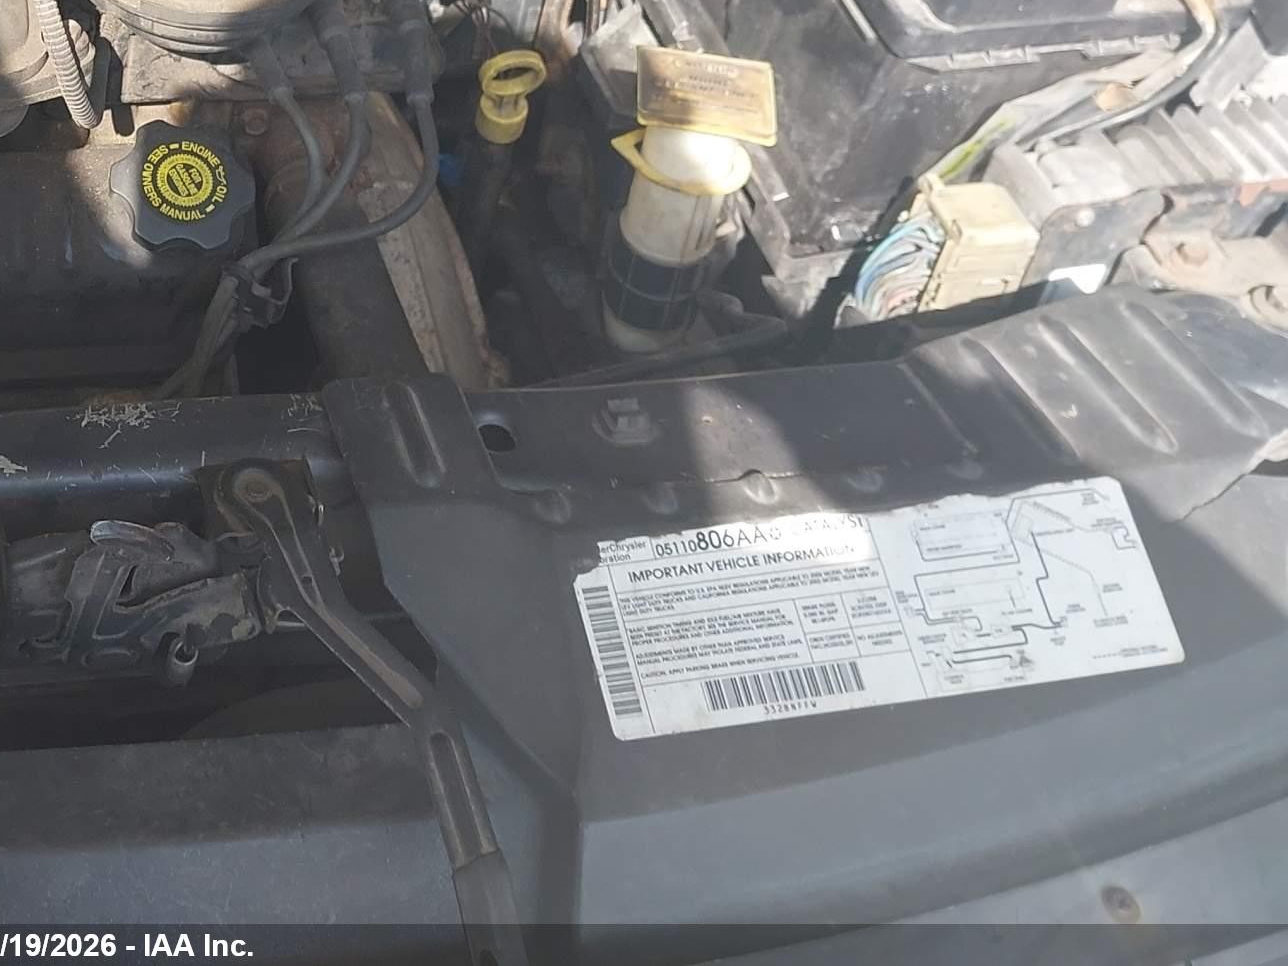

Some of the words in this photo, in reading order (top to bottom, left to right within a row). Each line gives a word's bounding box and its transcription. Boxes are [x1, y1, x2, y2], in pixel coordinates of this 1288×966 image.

[147, 144, 169, 165] SEE
[142, 162, 162, 207] OWNERS
[181, 140, 221, 167] ENGINE
[212, 185, 228, 203] OIL
[159, 203, 206, 221] MANUAL
[627, 562, 704, 584] IMPORTANT
[707, 555, 760, 572] VEHICLE
